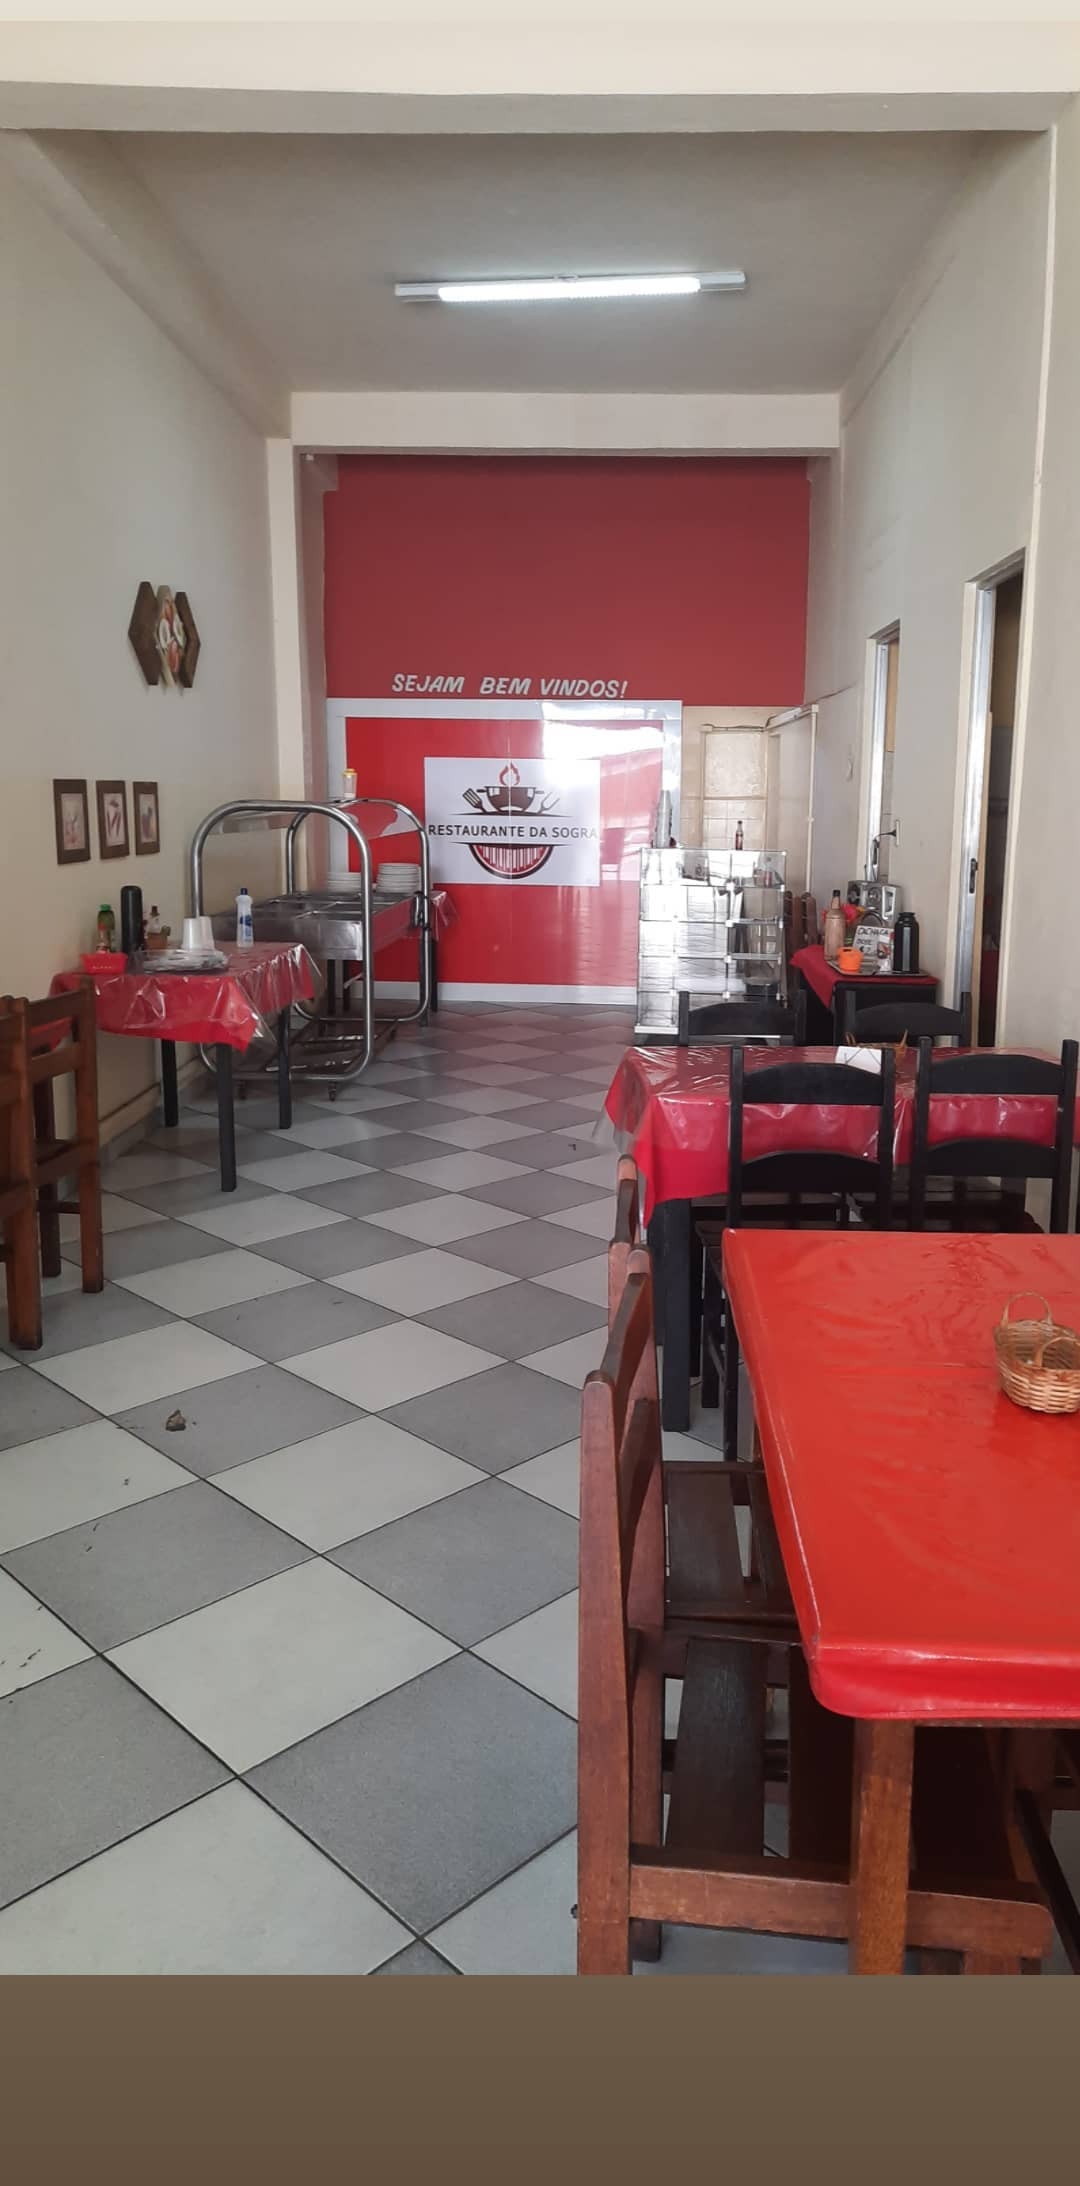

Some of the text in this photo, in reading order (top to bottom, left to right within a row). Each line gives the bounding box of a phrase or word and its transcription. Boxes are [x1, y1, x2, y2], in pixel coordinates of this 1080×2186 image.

[392, 673, 628, 698] SEJAM BEM VINDOS!
[428, 824, 597, 839] RESTAURANTE DA SOGRA
